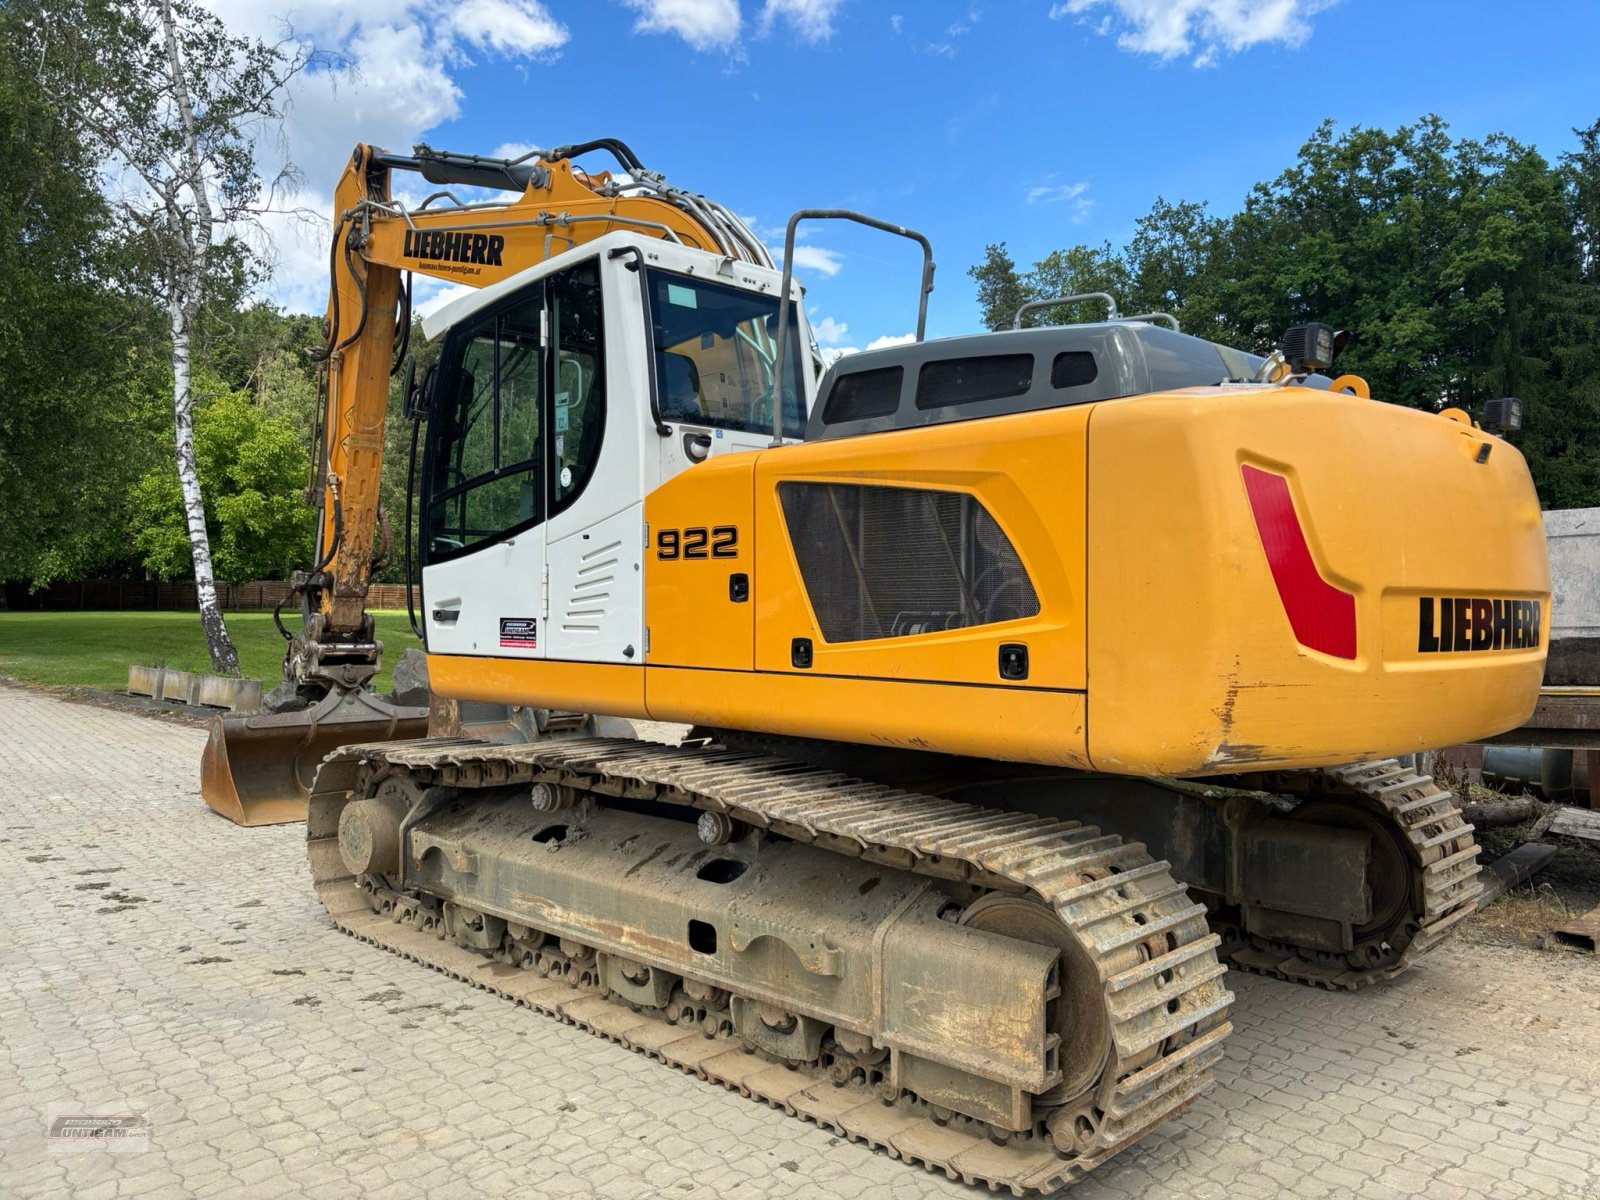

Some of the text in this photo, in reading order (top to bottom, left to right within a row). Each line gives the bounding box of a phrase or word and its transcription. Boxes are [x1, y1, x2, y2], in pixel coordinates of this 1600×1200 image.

[403, 229, 505, 266] LIEBHERR
[657, 525, 739, 561] 922
[1418, 597, 1541, 653] LIEBHERR
